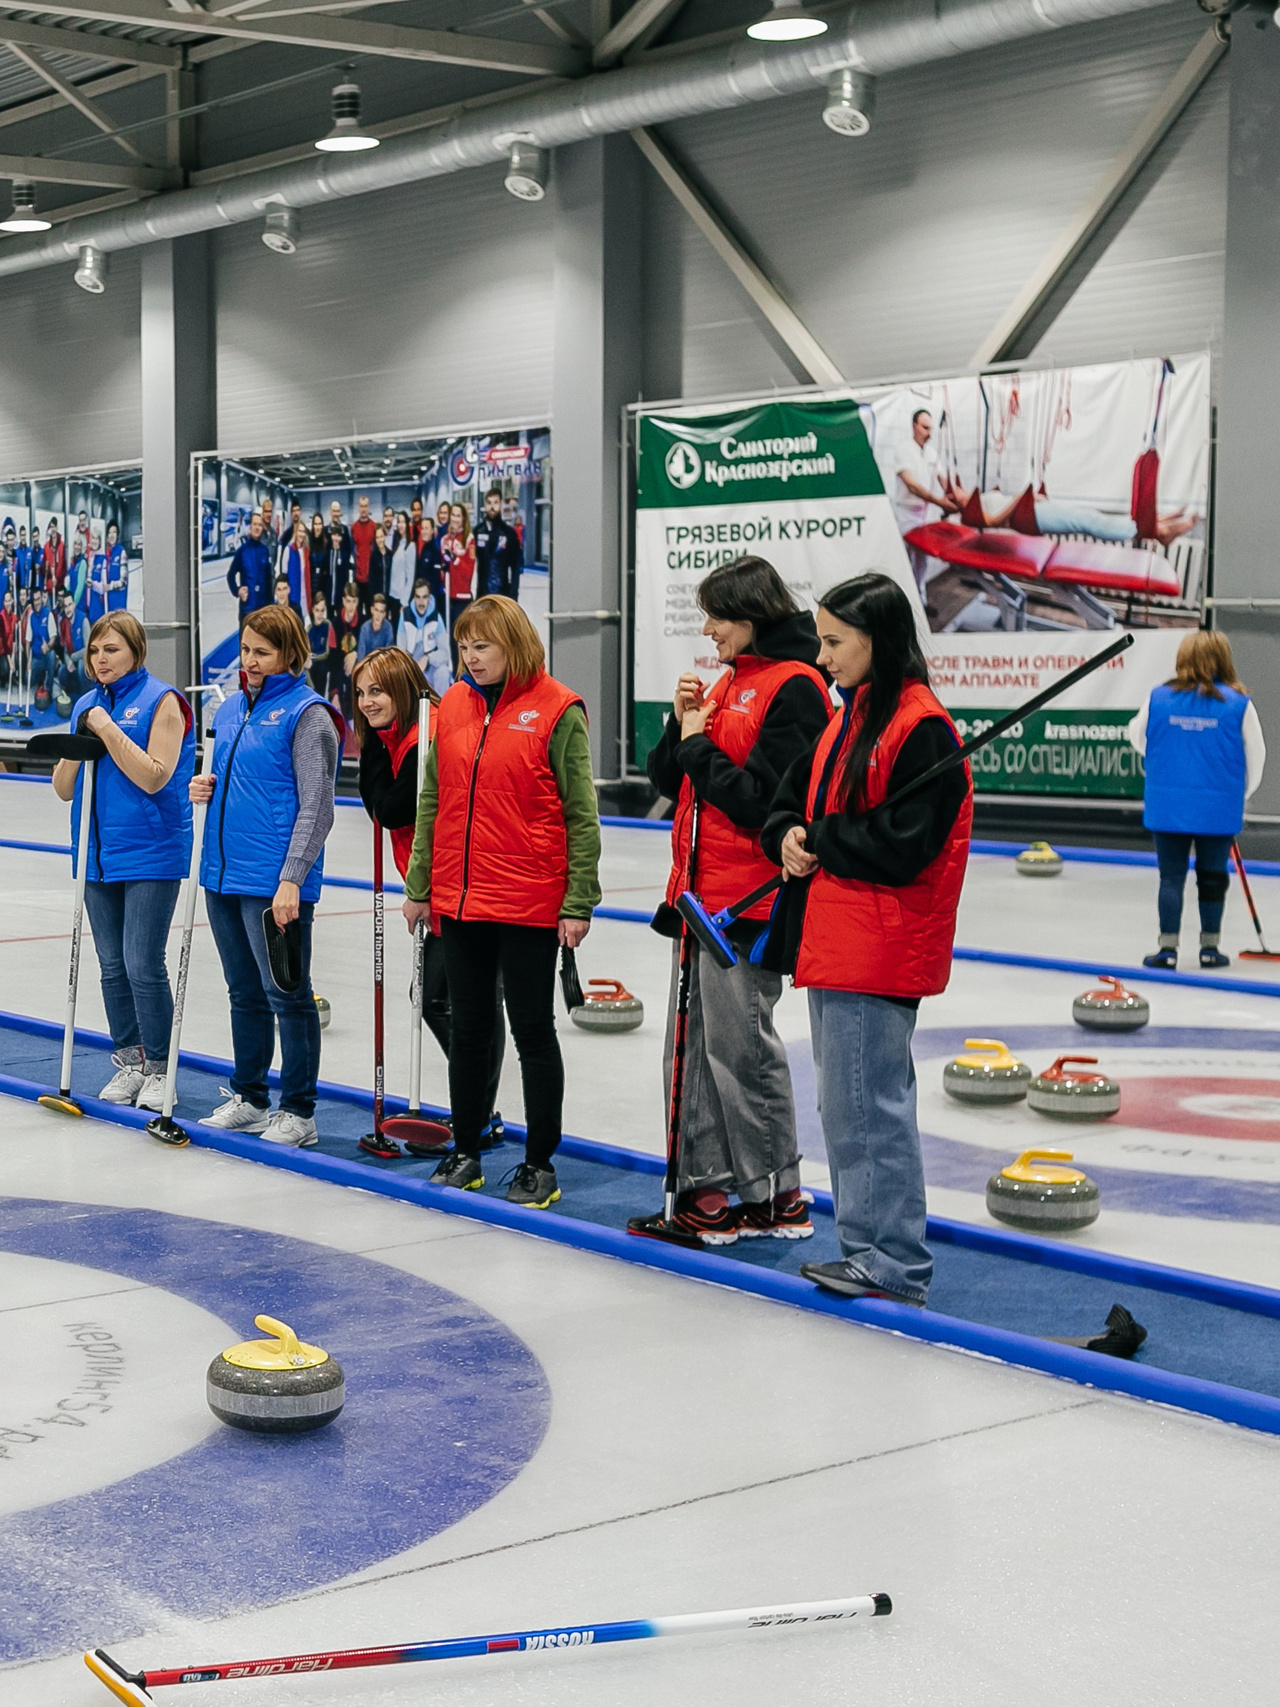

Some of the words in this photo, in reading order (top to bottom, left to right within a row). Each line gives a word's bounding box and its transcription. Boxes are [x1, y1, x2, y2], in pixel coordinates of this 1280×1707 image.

[665, 516, 772, 546] ГРЯЗЕВОЙ
[778, 516, 866, 541] КУРОРТ
[962, 655, 1014, 670] ТРАВМ
[1018, 655, 1029, 669] И
[959, 674, 1040, 689] АППАРАТЕ
[375, 892, 384, 934] VAPOR
[226, 1658, 333, 1679] Hardline
